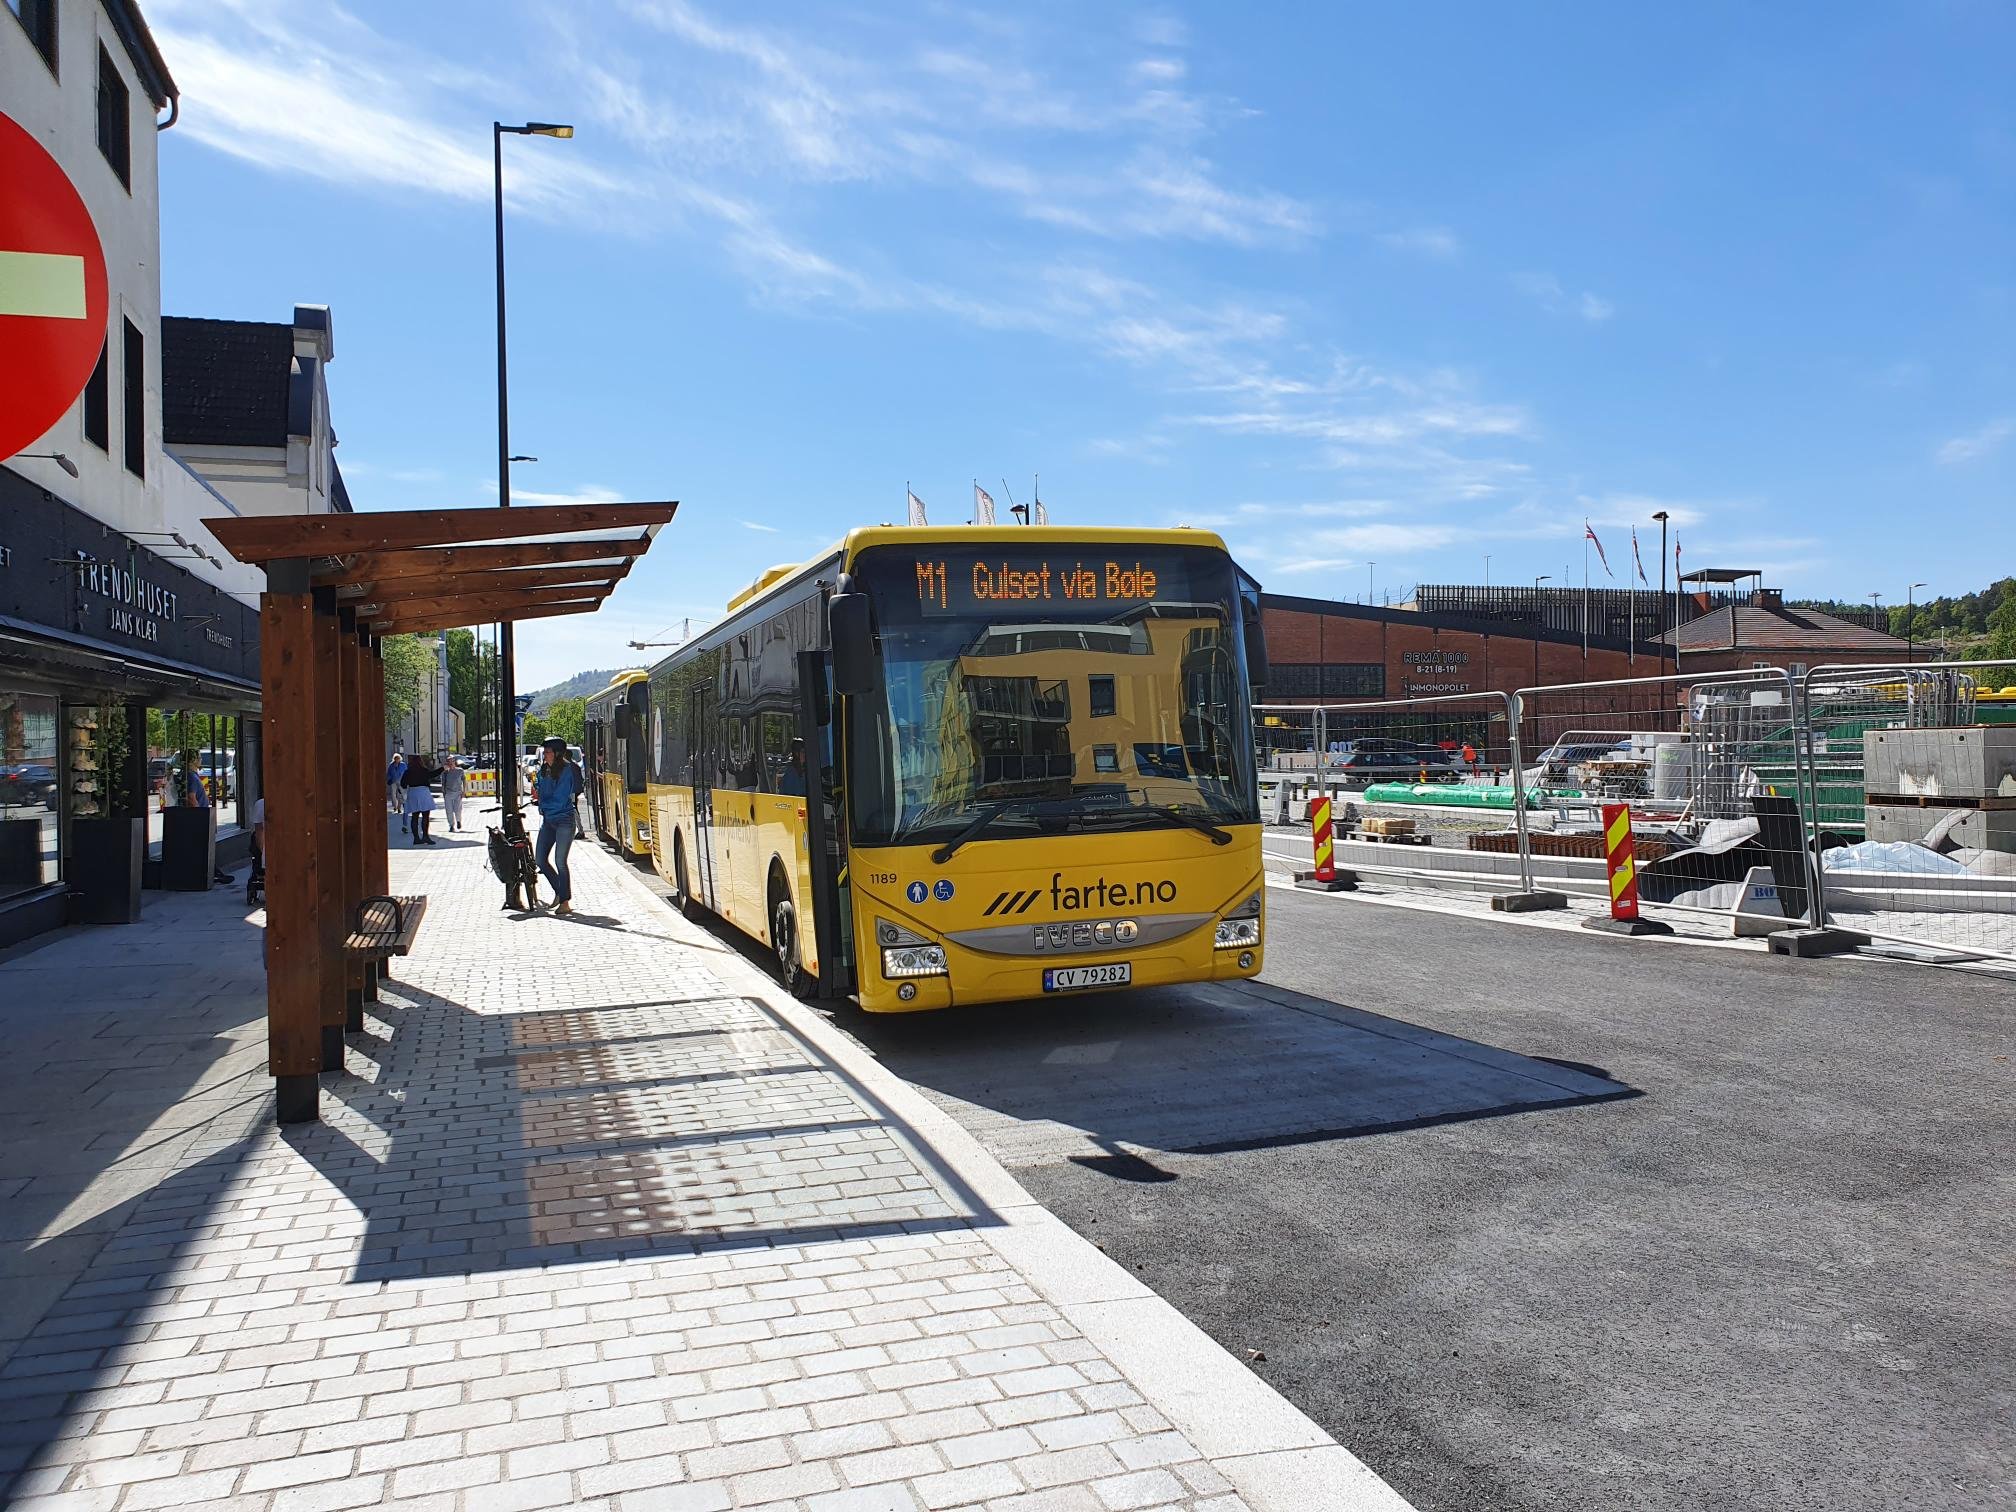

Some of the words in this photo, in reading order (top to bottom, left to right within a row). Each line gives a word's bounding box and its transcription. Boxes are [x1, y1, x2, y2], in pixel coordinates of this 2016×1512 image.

[916, 561, 947, 609] M1
[972, 561, 1051, 599] Gulset
[1061, 562, 1096, 599] via
[1105, 561, 1157, 599] Bøle
[111, 608, 133, 634] JANS
[135, 616, 158, 642] KLÆR
[1403, 652, 1440, 664] REMA
[1442, 652, 1469, 664] 1000
[1416, 665, 1433, 673] 8-21
[1404, 683, 1470, 692] INMONOPOLET
[870, 873, 897, 884] 1189
[1051, 872, 1177, 911] farte.no
[1034, 919, 1139, 950] IVECO
[1056, 971, 1075, 986] CV
[1081, 966, 1126, 984] 79282
